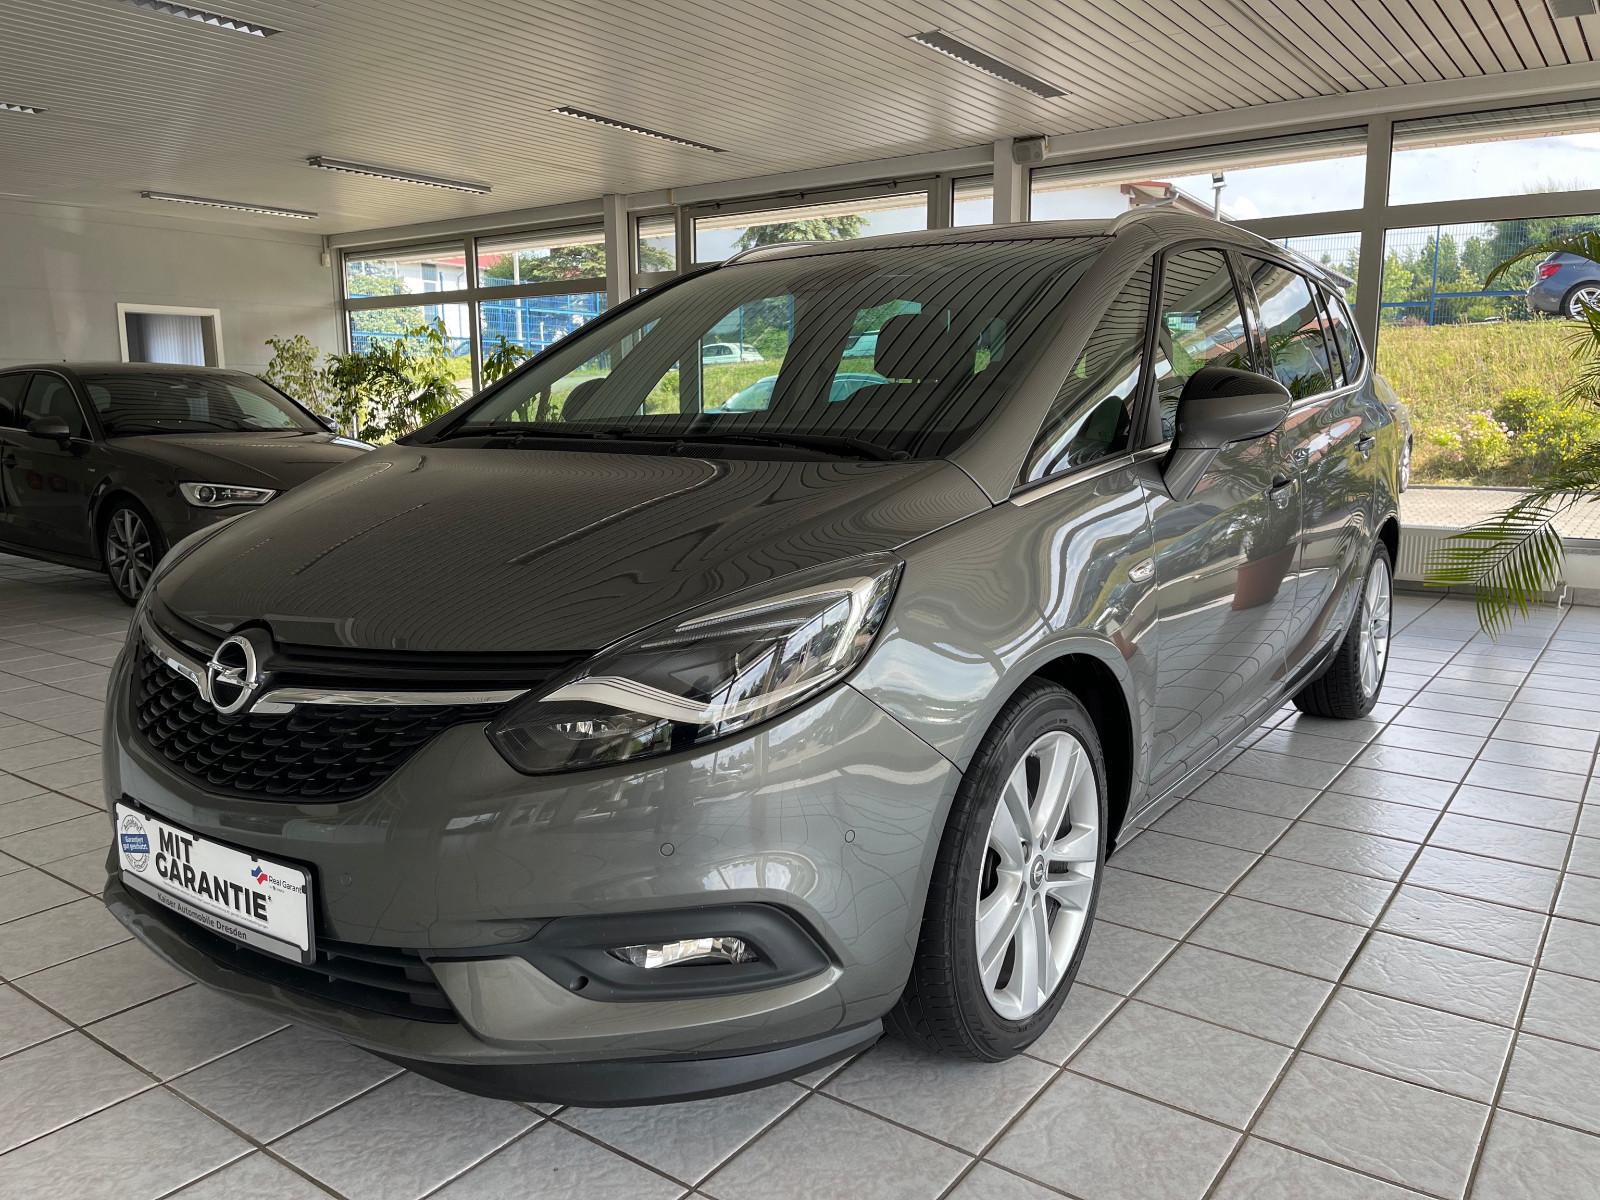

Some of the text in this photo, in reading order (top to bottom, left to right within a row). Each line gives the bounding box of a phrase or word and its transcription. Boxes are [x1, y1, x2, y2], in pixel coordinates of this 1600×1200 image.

[159, 827, 193, 864] MIT
[269, 876, 282, 887] Real
[282, 880, 303, 894] Garant
[156, 892, 176, 908] Kaiser
[177, 903, 215, 928] Automobile
[216, 920, 248, 941] Dresden
